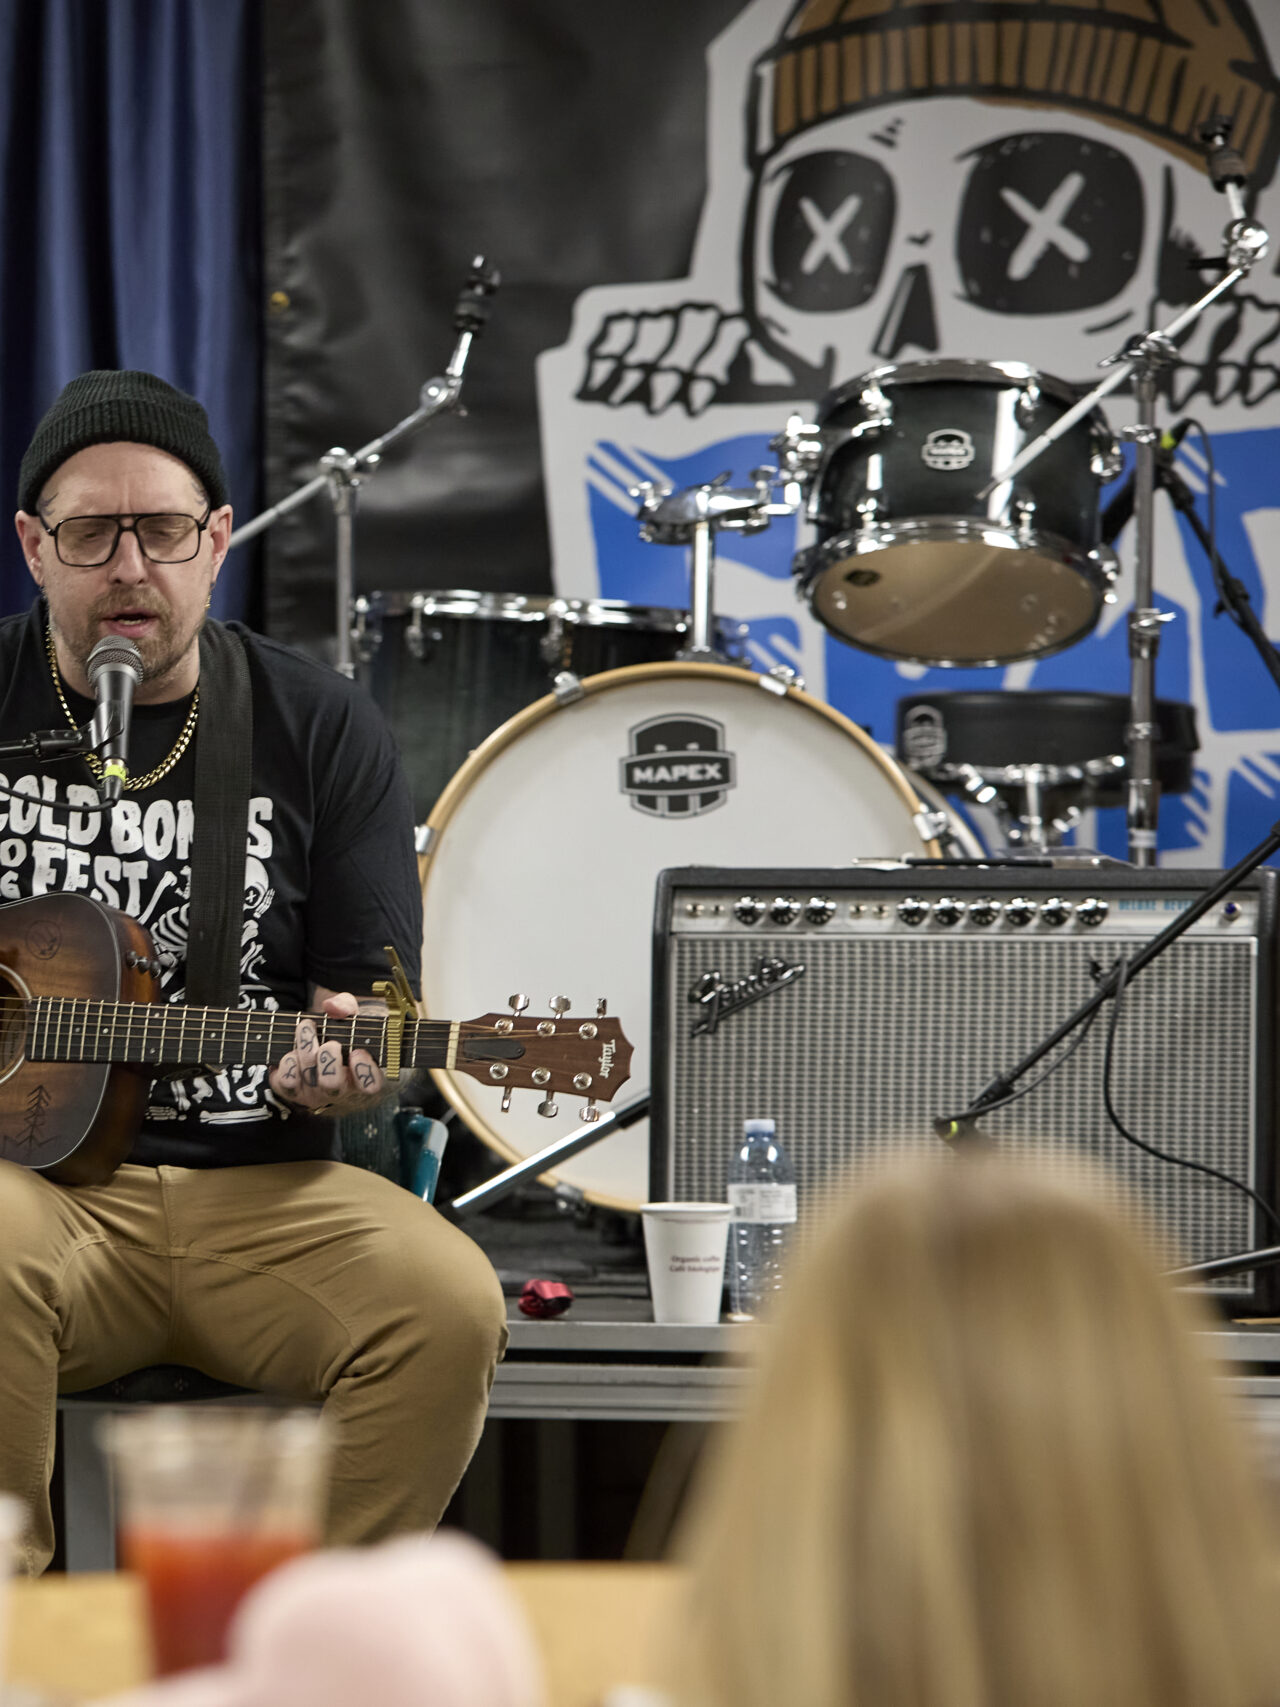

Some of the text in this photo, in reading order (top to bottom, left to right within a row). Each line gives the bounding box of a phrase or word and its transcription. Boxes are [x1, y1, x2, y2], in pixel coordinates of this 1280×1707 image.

[632, 763, 722, 784] MAPEX
[31, 839, 149, 916] FEST
[598, 1038, 617, 1080] Taylor
